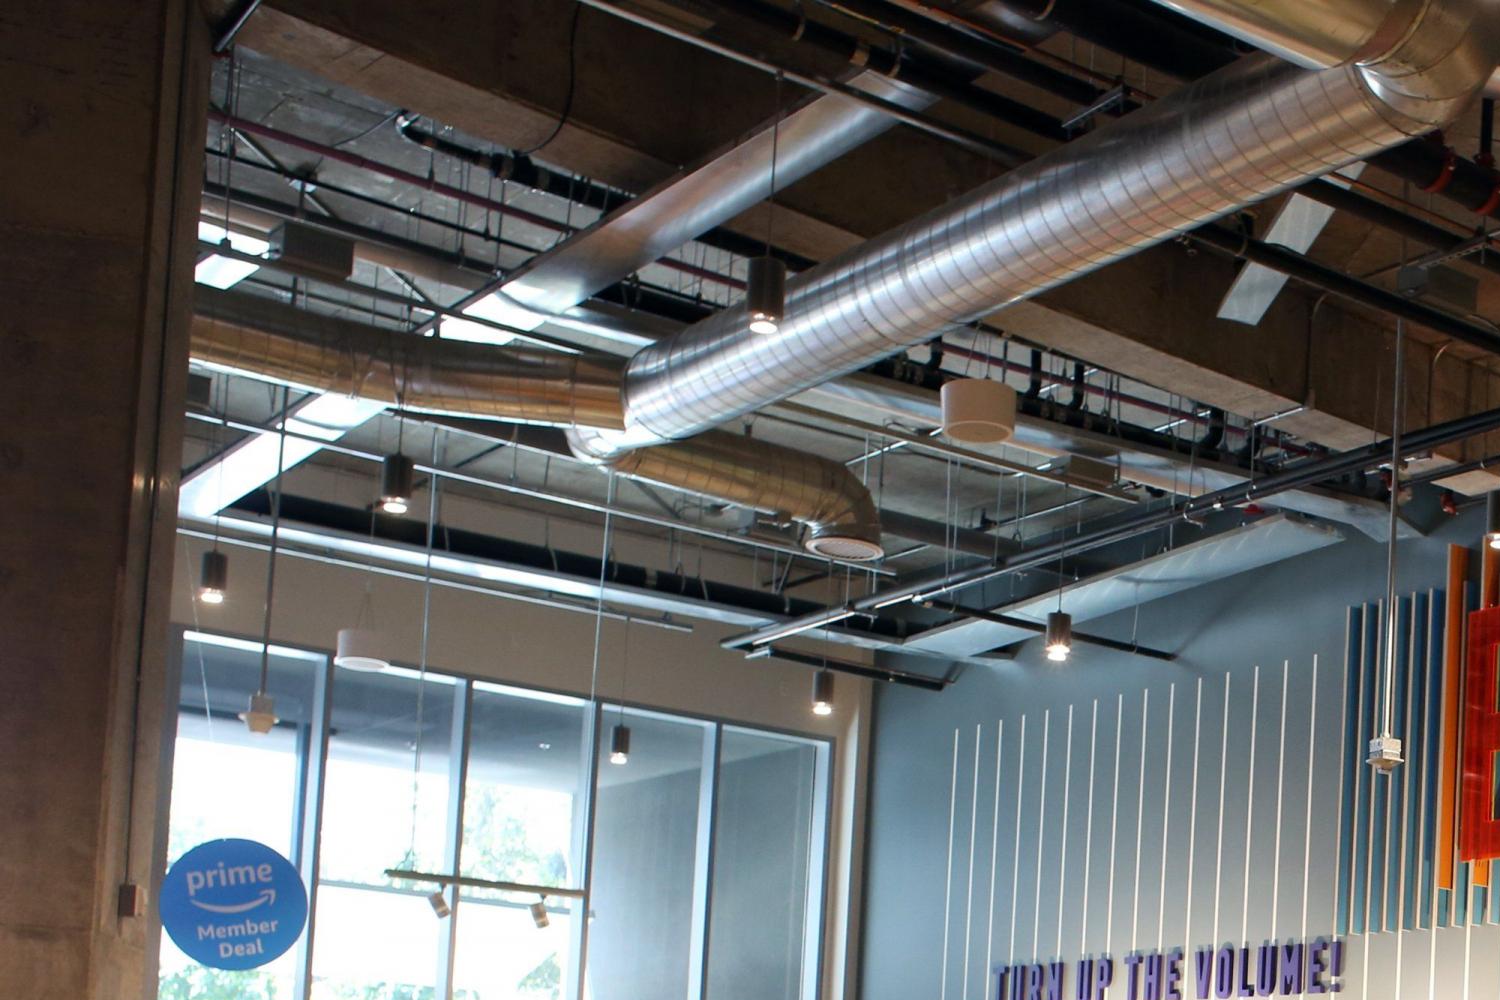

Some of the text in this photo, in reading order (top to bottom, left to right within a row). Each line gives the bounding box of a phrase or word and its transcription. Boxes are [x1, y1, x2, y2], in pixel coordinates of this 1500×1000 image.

[186, 862, 273, 896] prime
[197, 919, 279, 941] Member
[219, 939, 264, 959] Deal
[1194, 938, 1343, 999] VOLUME!
